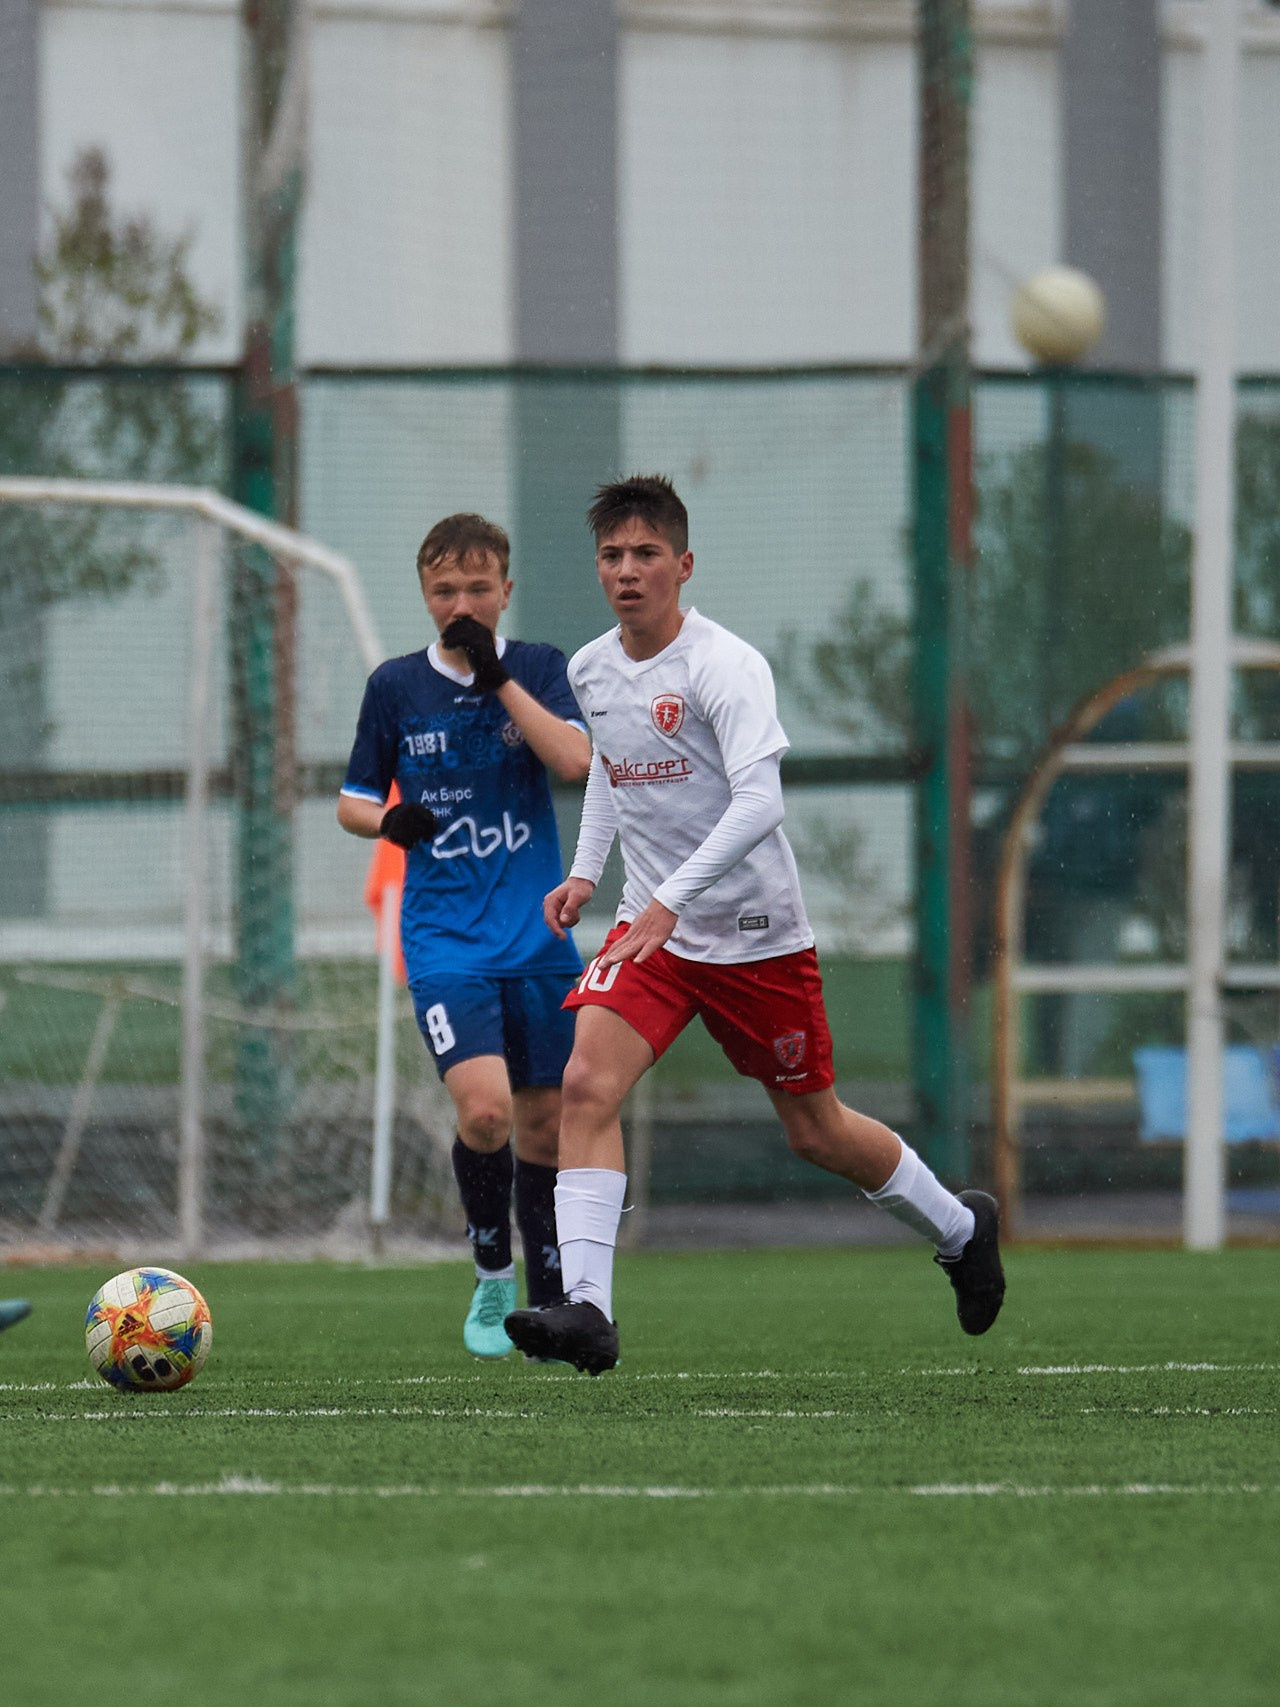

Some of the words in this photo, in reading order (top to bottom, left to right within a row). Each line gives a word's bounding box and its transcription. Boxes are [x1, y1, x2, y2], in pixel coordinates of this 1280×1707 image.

[404, 731, 446, 756] 1981
[420, 789, 438, 804] Ак
[440, 787, 473, 804] Барс
[425, 1003, 456, 1056] 8
